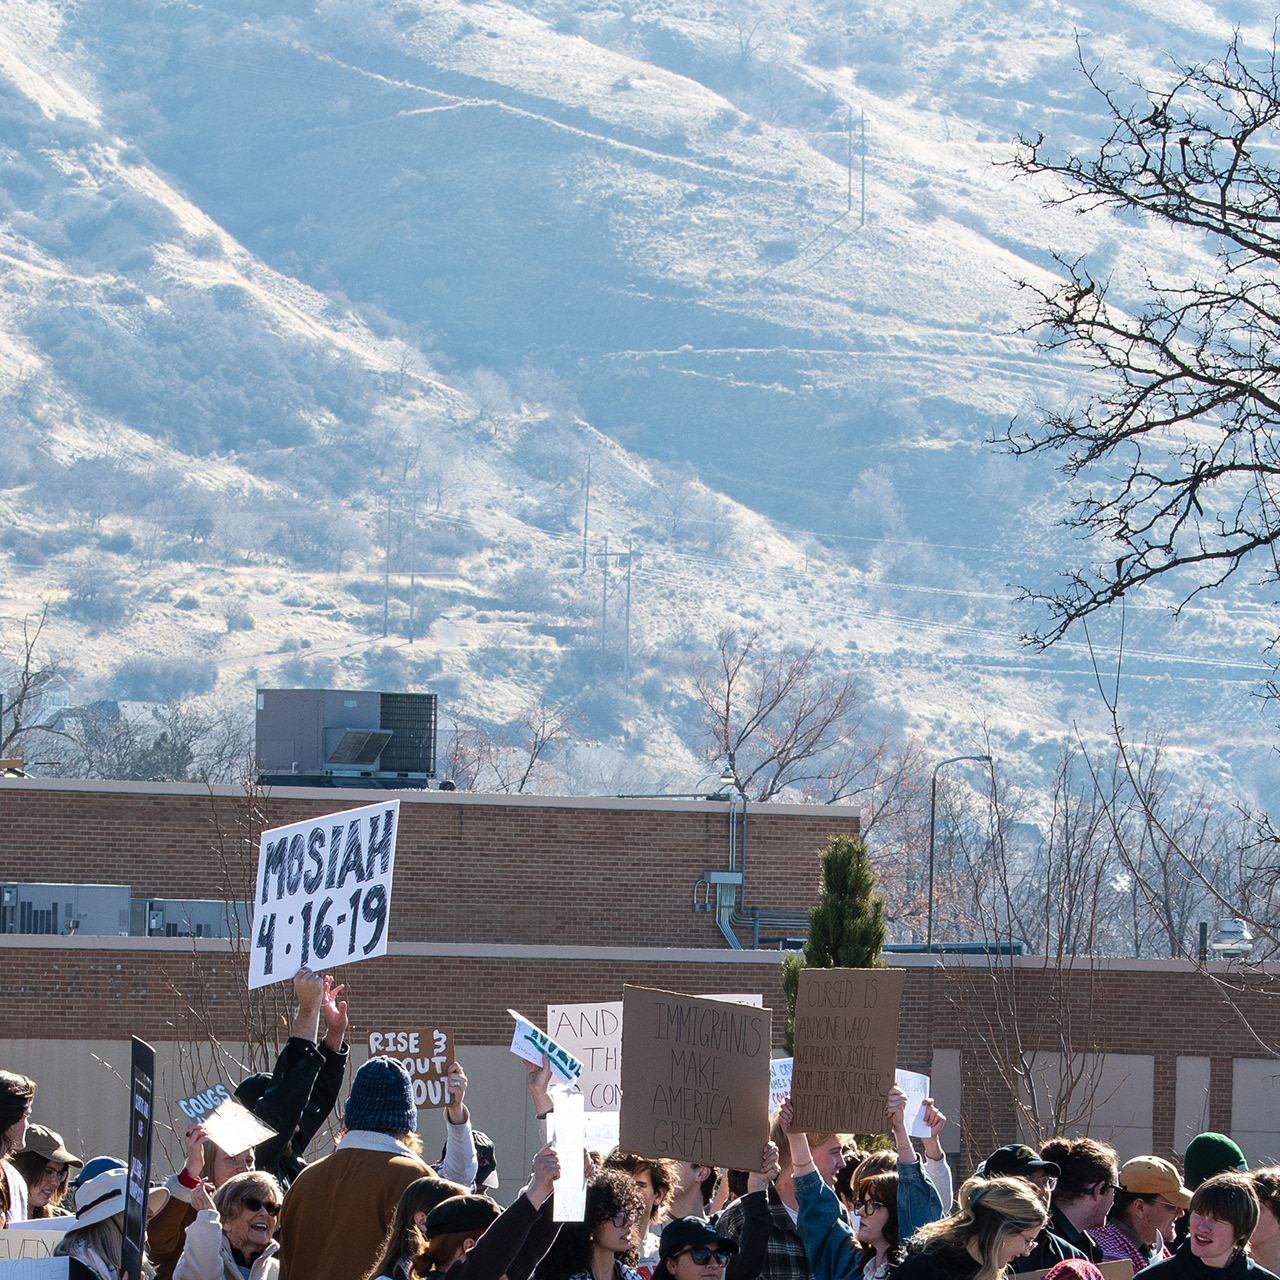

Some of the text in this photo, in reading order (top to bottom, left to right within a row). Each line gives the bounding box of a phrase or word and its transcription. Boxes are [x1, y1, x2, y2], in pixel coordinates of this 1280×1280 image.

[261, 809, 395, 905] MOSIAH
[256, 883, 387, 975] 4:16-19
[864, 979, 878, 1008] IS
[369, 1031, 420, 1055] RISE
[654, 1003, 762, 1057] IMMIGRANTS
[798, 1016, 870, 1040] ANYONE WHO
[671, 1049, 721, 1090] MAKE
[844, 1045, 876, 1070] JUSTICE
[794, 1070, 830, 1092] FROM THE
[177, 1084, 232, 1118] COUGS
[652, 1084, 733, 1127] AMERICA
[795, 1094, 865, 1130] DEUTERONOMY
[652, 1119, 716, 1161] GREAT.
